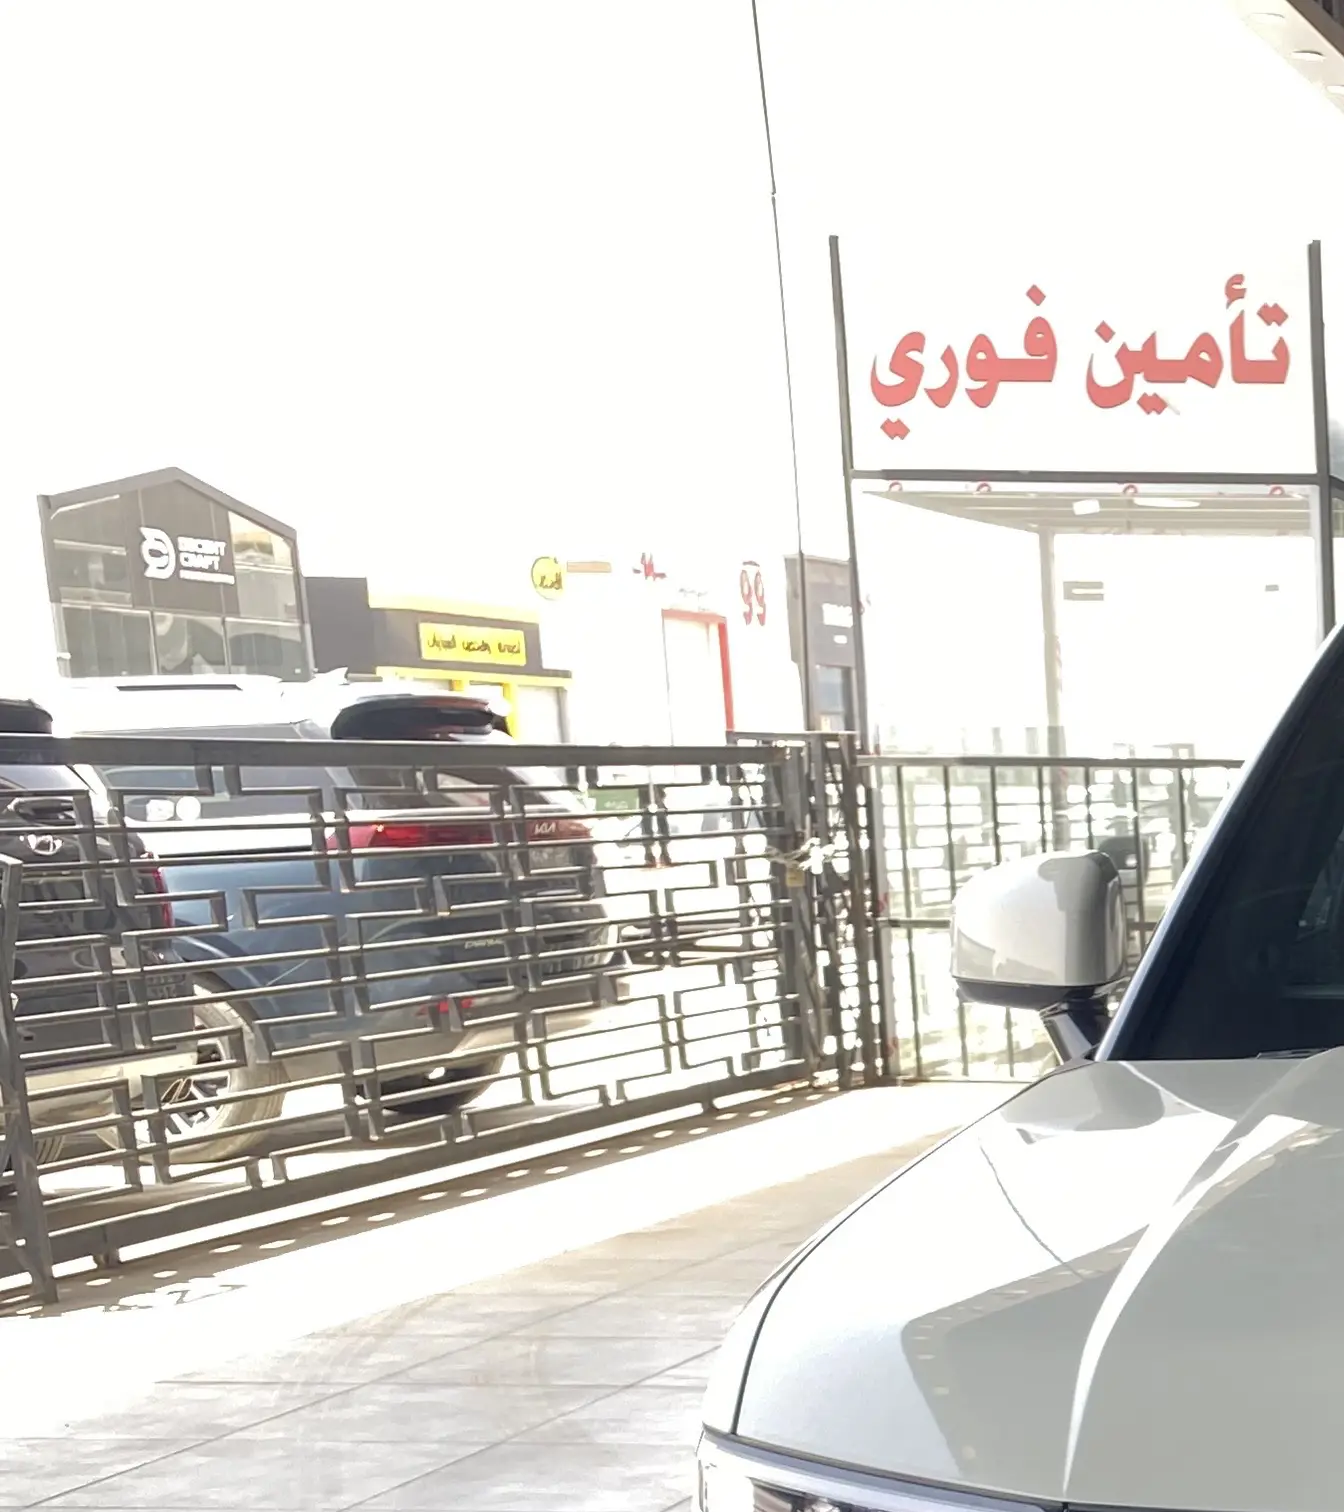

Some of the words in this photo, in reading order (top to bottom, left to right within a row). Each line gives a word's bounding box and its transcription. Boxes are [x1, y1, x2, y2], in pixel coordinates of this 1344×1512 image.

[871, 284, 1058, 441] فوري
[1086, 273, 1291, 415] تأمين
[533, 822, 556, 835] KIA
